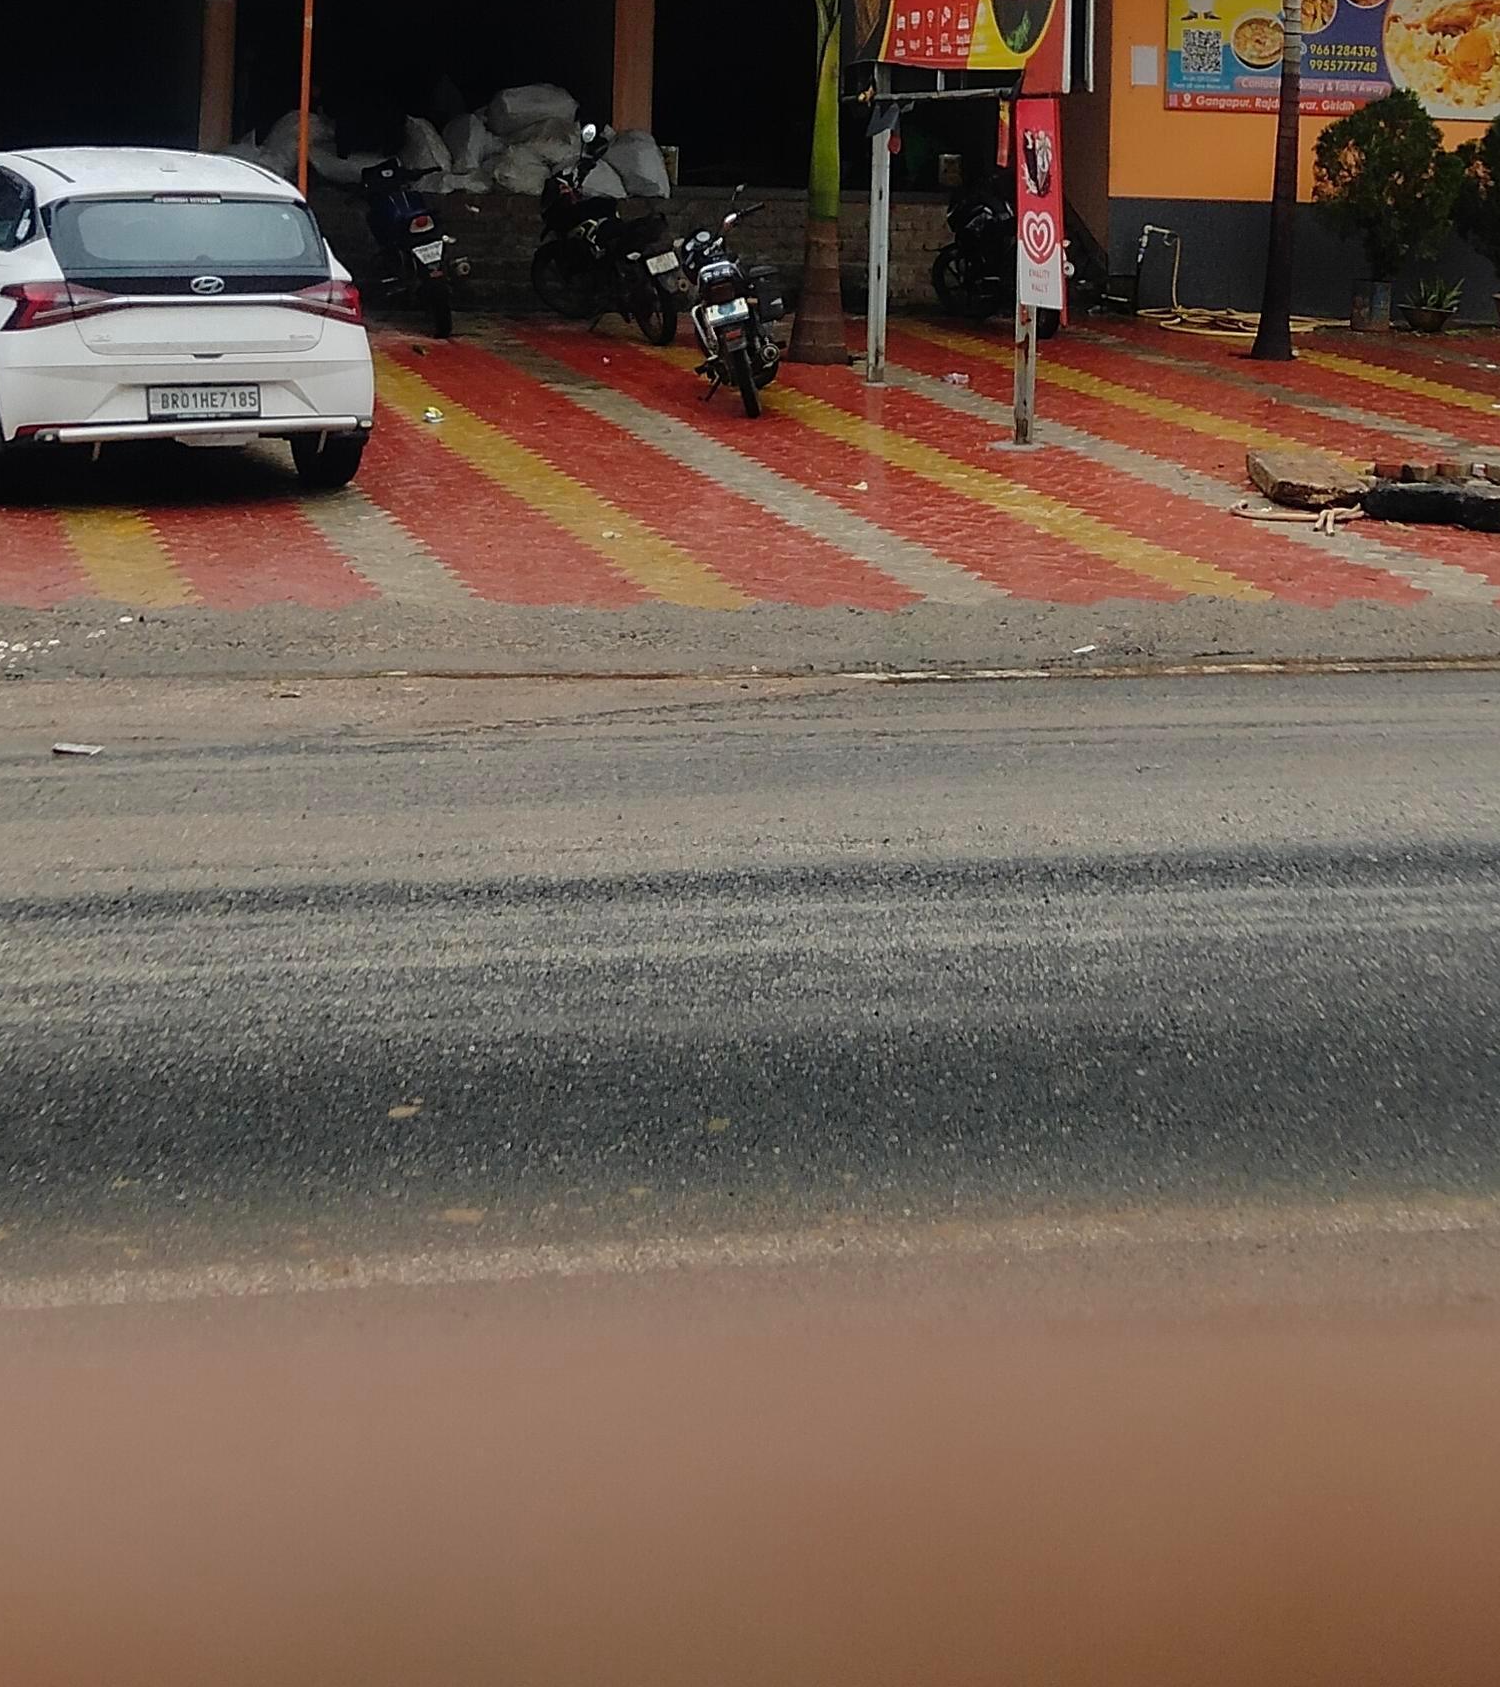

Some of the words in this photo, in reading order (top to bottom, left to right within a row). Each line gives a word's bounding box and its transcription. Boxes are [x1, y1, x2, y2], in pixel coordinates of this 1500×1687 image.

[1310, 43, 1378, 58] 9661284396
[1309, 59, 1378, 73] 9955777748
[1322, 100, 1355, 111] Giridih
[161, 391, 258, 409] BR01HE7185
